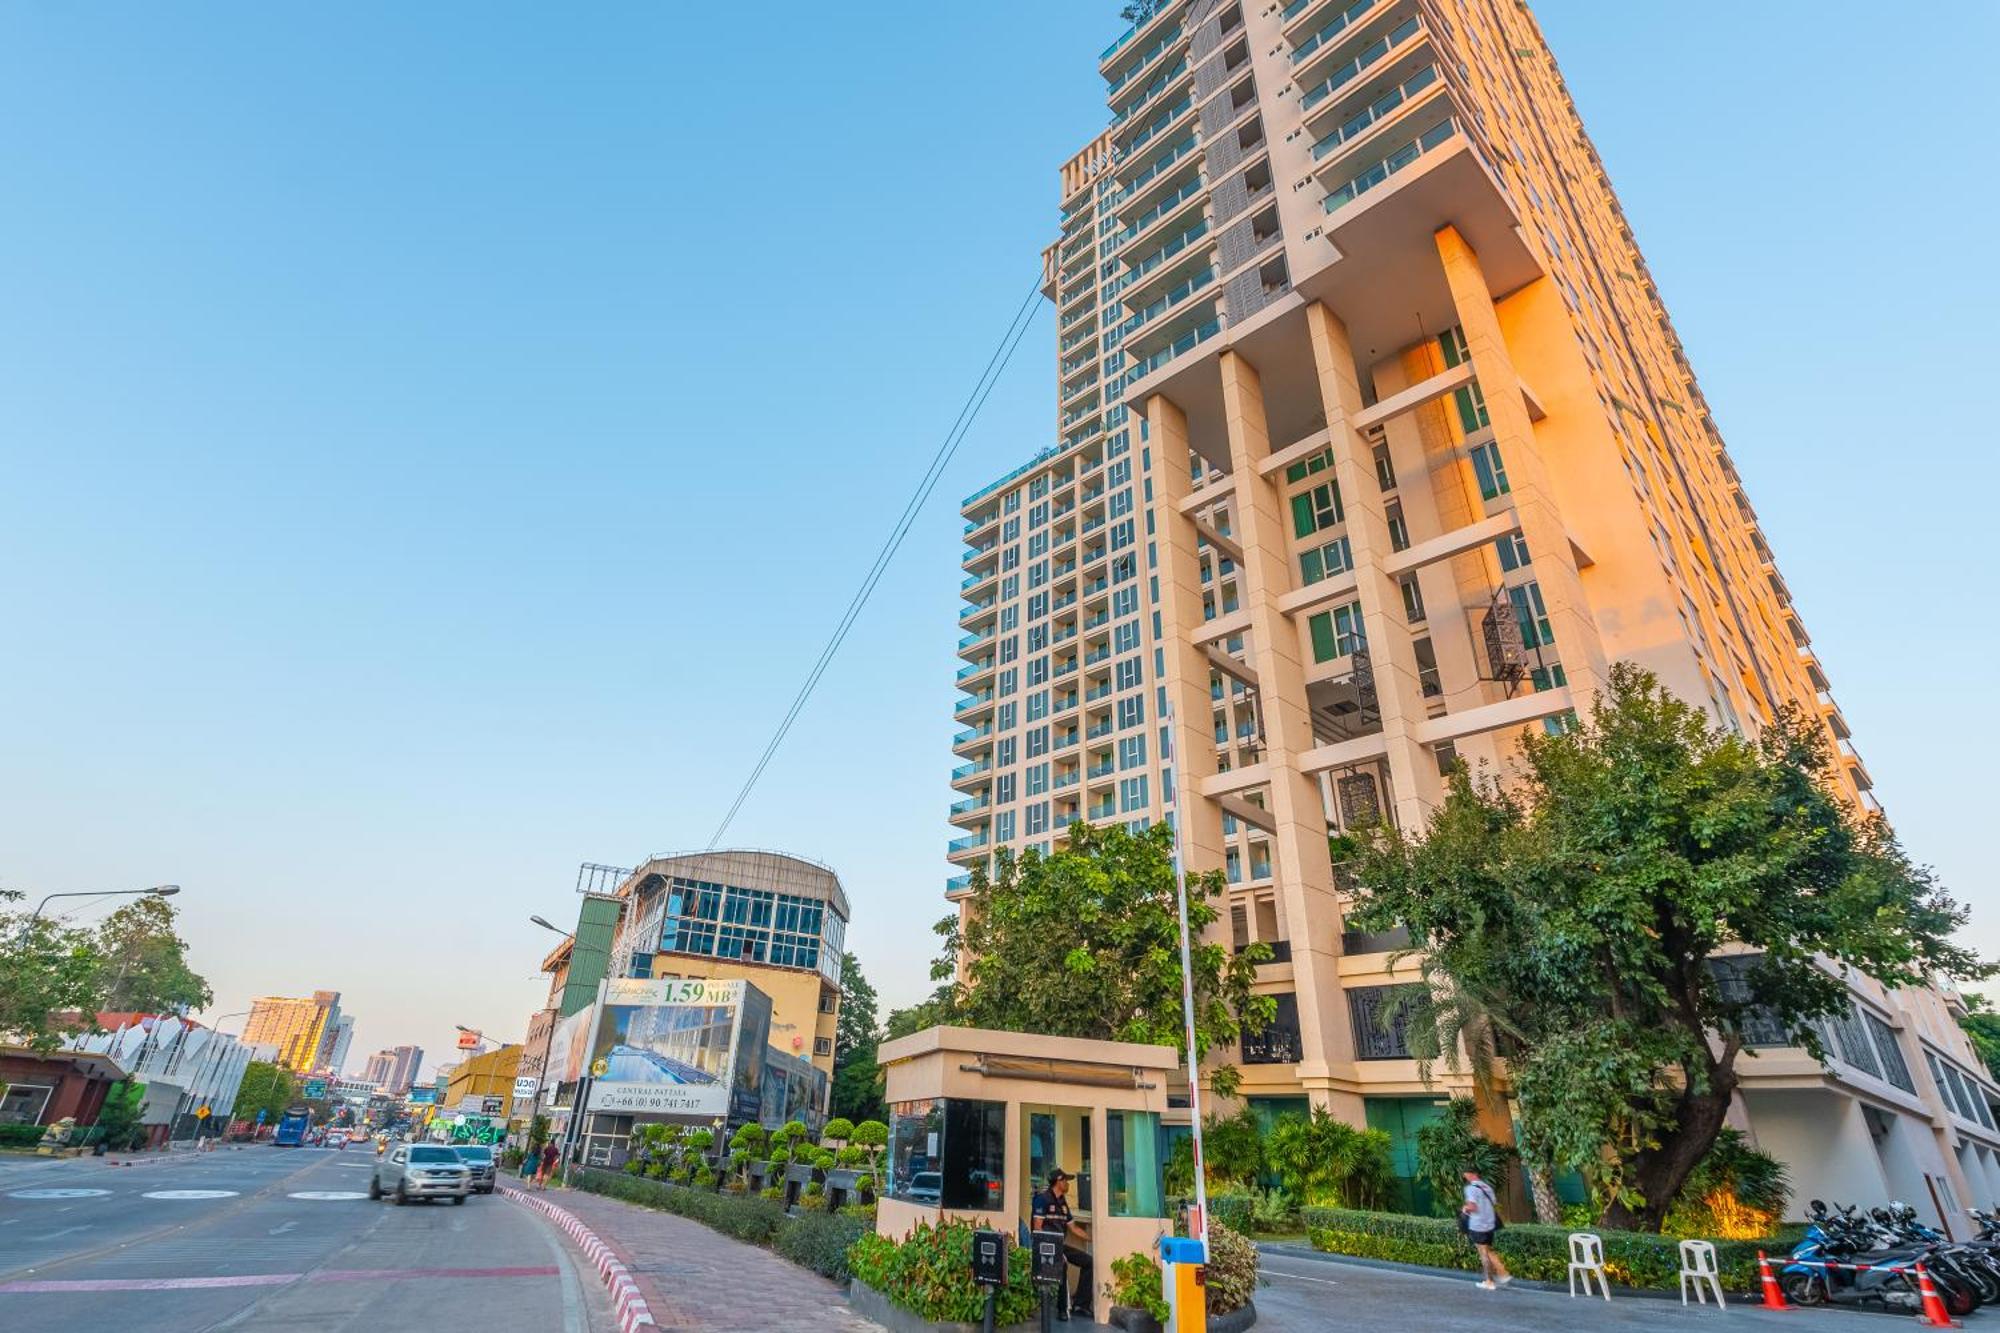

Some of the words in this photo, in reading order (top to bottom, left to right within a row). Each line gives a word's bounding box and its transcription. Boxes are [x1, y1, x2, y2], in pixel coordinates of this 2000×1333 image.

[664, 983, 704, 1002] 1.59
[616, 1087, 652, 1095] CENTRAL
[615, 1097, 633, 1106] +66
[635, 1097, 647, 1106] (0)
[650, 1098, 660, 1106] 90
[663, 1098, 677, 1107] 741
[681, 1099, 701, 1108] 7417
